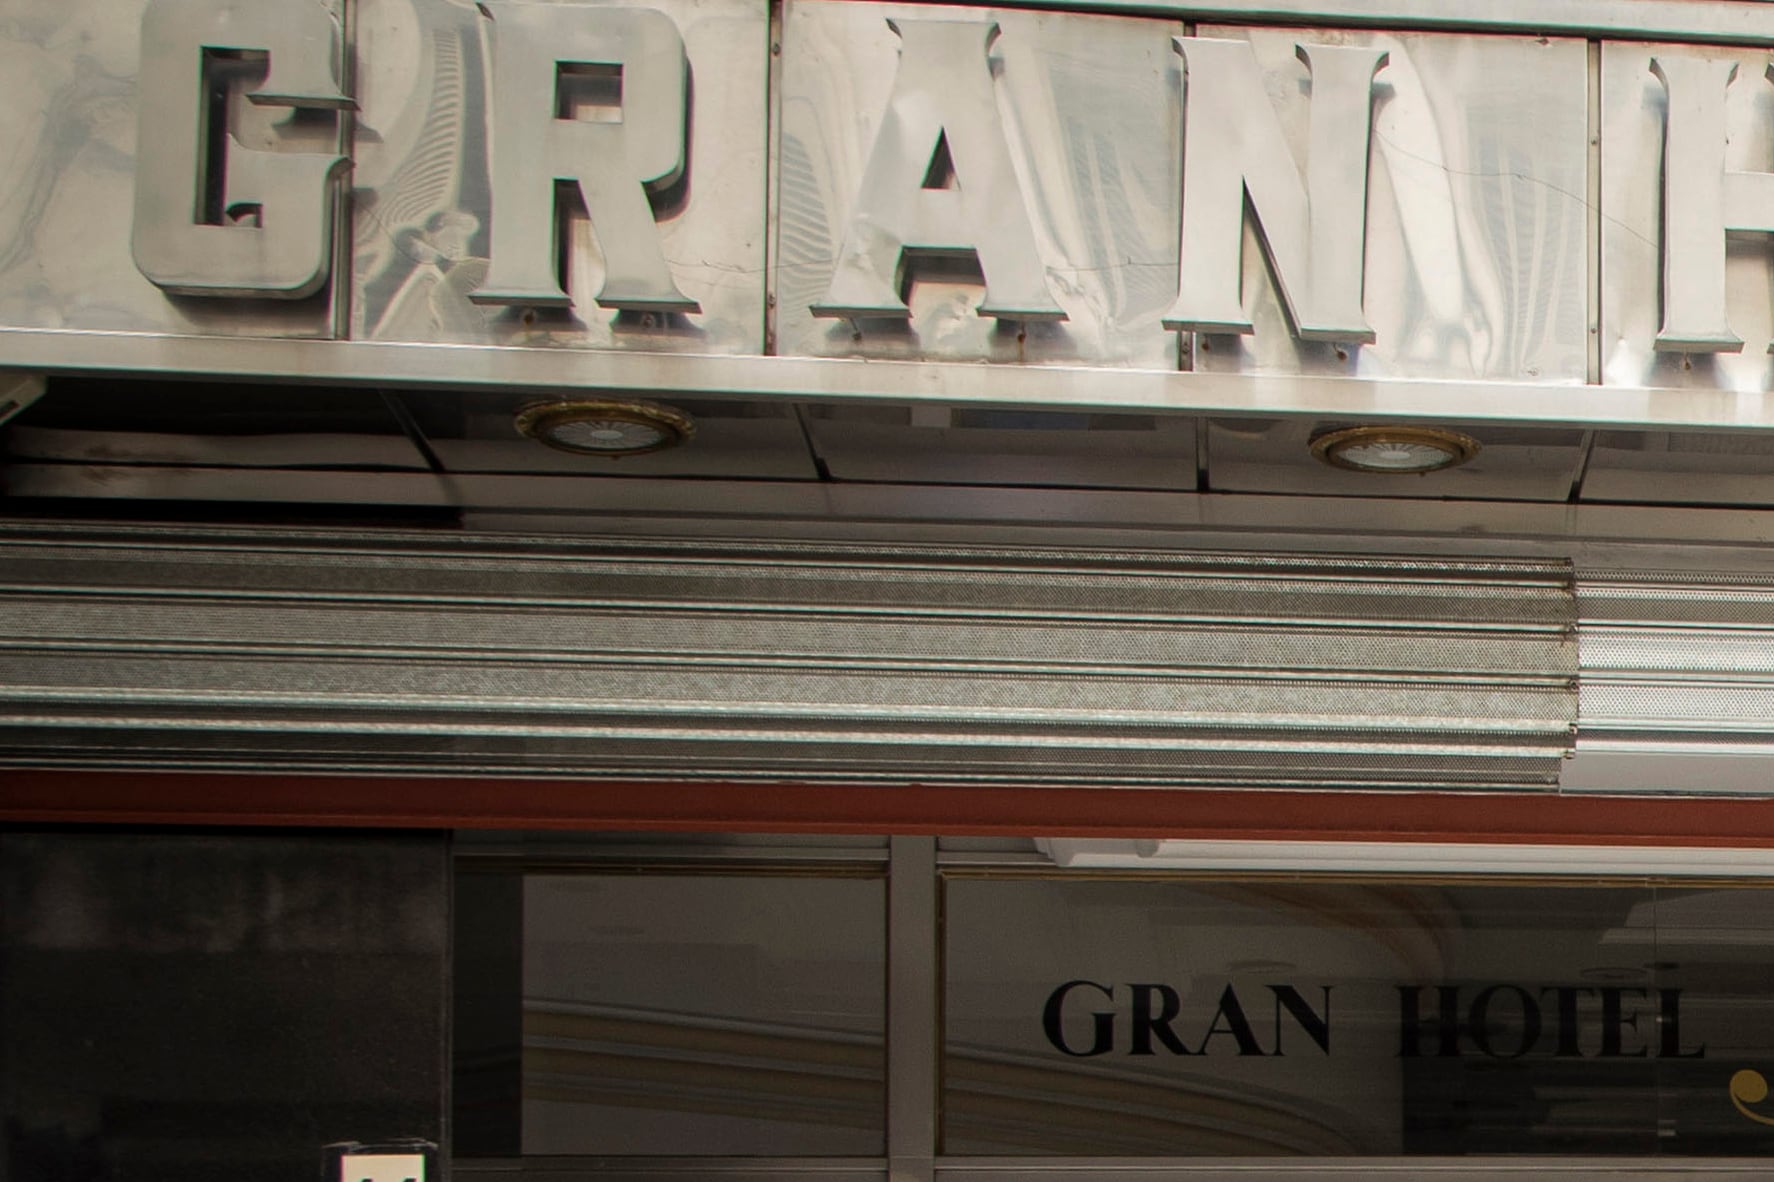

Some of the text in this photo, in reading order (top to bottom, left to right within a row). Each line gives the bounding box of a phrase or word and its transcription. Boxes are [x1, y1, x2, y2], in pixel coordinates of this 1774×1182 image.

[132, 0, 1388, 345] GRAN
[1041, 979, 1334, 1058] GRAN
[1392, 982, 1706, 1060] HOTEL
